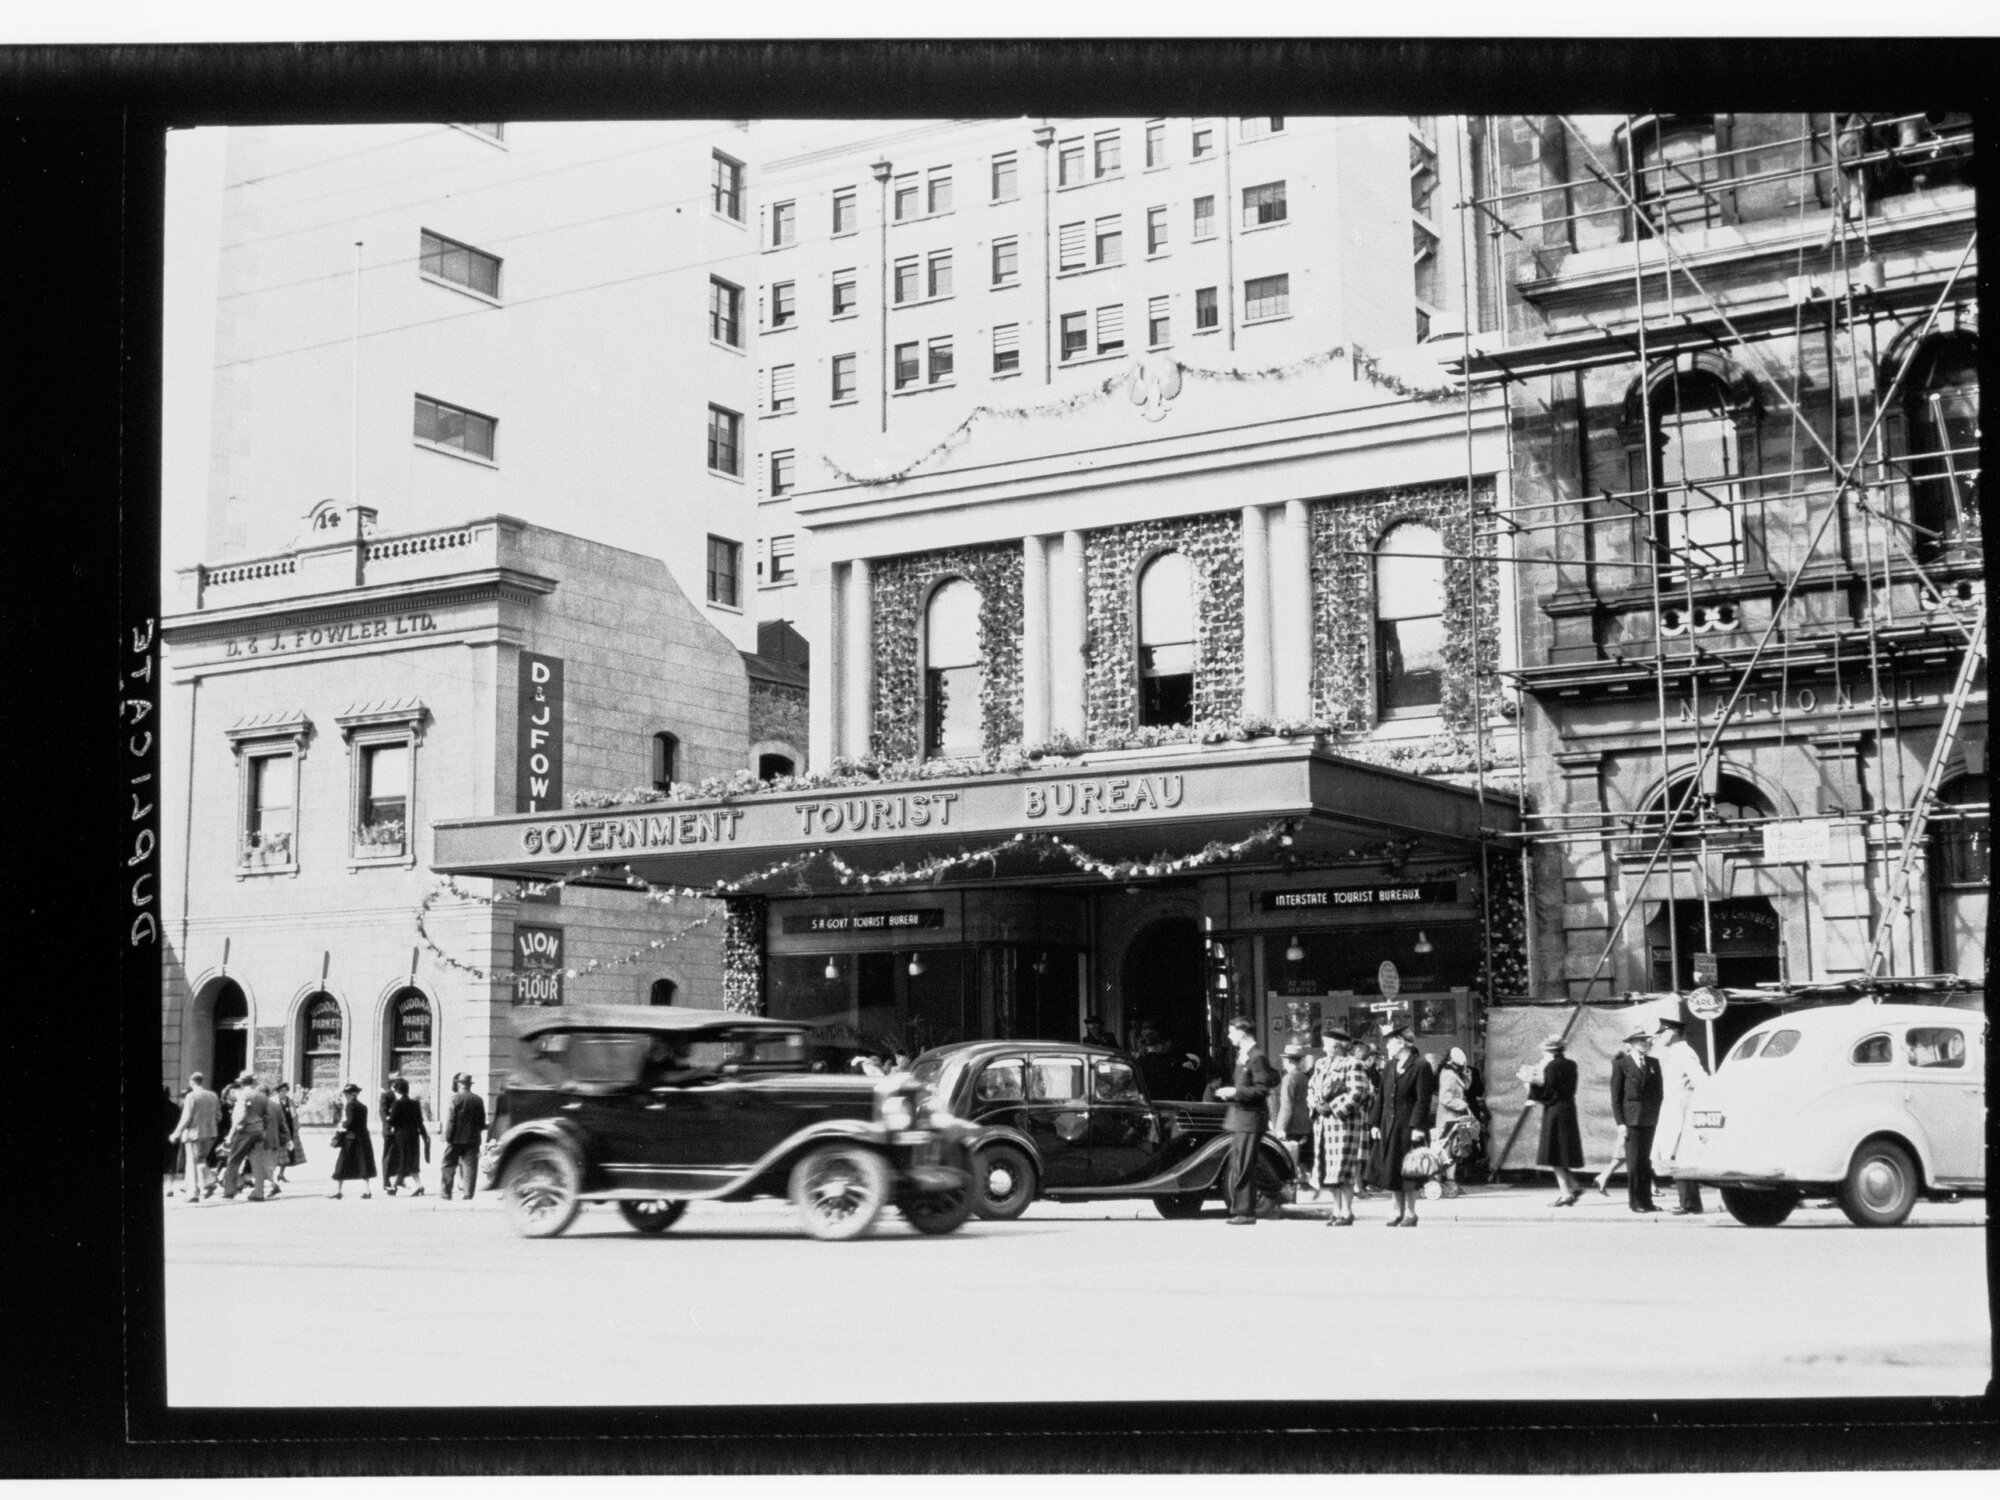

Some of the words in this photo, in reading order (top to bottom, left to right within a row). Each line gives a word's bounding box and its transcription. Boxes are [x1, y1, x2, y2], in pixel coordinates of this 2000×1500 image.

[319, 512, 342, 530] 14
[271, 633, 286, 652] J.
[295, 619, 388, 649] FOWLER
[395, 612, 438, 636] LTD.
[1679, 679, 1924, 722] NATIONAL
[522, 809, 744, 855] GOVERNMENT
[794, 792, 958, 834] TOURIST
[1024, 774, 1184, 819] BUREAU
[1275, 892, 1328, 906] INTERSTATE
[1333, 890, 1374, 904] TOURIST
[1379, 887, 1421, 902] BUREAUX
[812, 919, 818, 930] S
[853, 915, 886, 928] TOURIST
[888, 913, 919, 926] BUREAU
[519, 931, 559, 958] LION
[518, 978, 558, 1000] FLOUR
[311, 1018, 342, 1030] PARKER
[402, 1015, 430, 1026] PARKER
[406, 1030, 425, 1042] LINE
